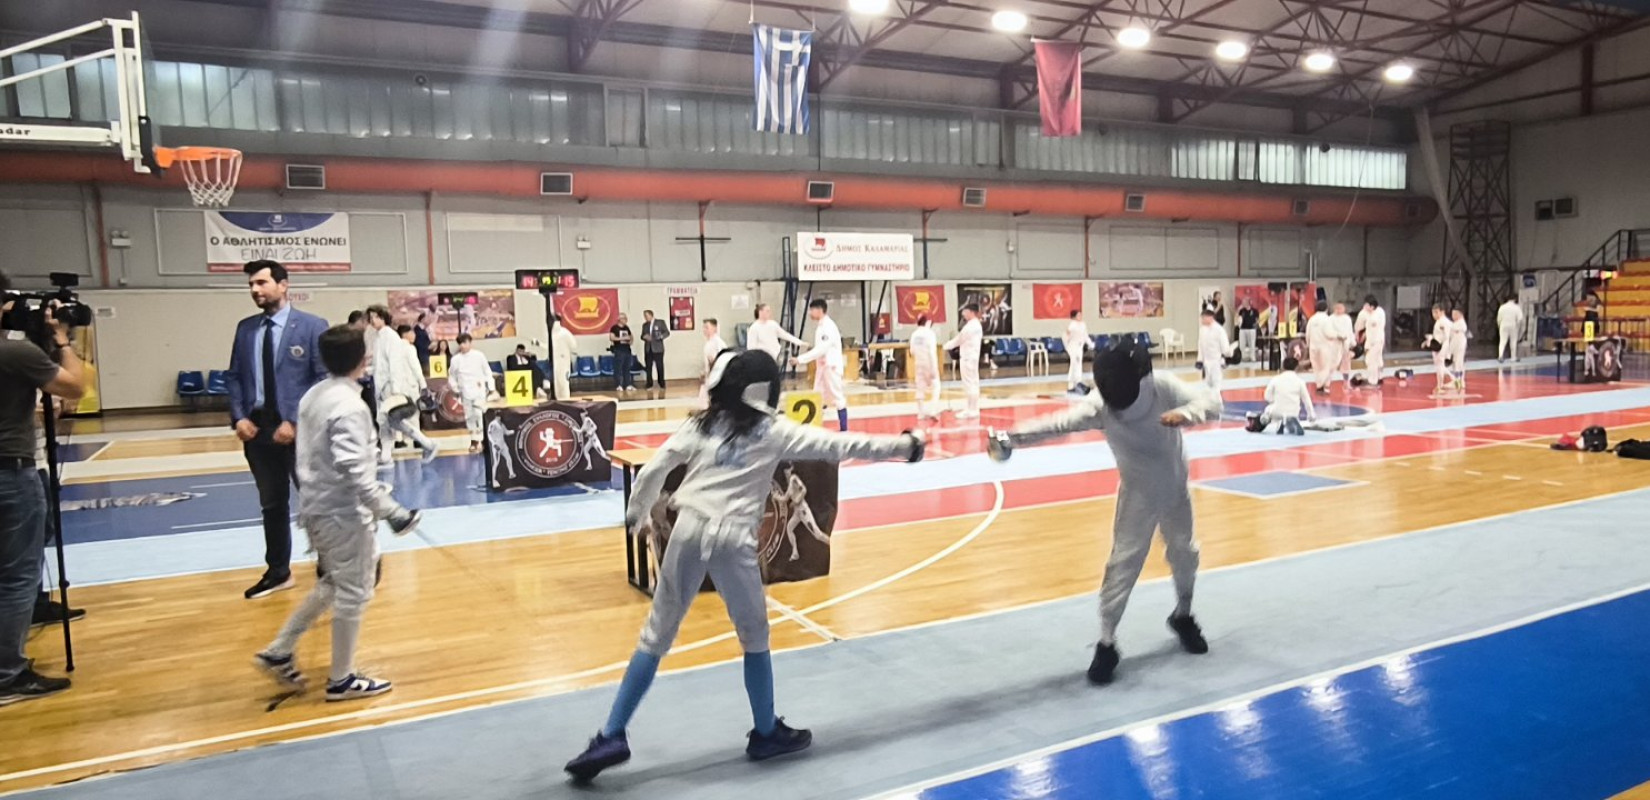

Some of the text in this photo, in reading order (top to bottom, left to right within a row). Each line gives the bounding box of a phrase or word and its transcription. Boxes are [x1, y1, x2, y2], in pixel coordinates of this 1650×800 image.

[223, 236, 300, 246] ΑΘΛΗΤΙΣΜΟΣ
[304, 237, 346, 246] ΕΝΩΝΕΙ
[241, 247, 317, 261] ΕΙΝΑΙ ΖΩΗ
[803, 263, 831, 272] ΚΛΕΙΣΤΟ
[833, 263, 866, 272] ΔΗΜΟΤΙΚΟ
[434, 361, 442, 372] 6
[512, 376, 528, 397] 4
[792, 399, 817, 425] 2
